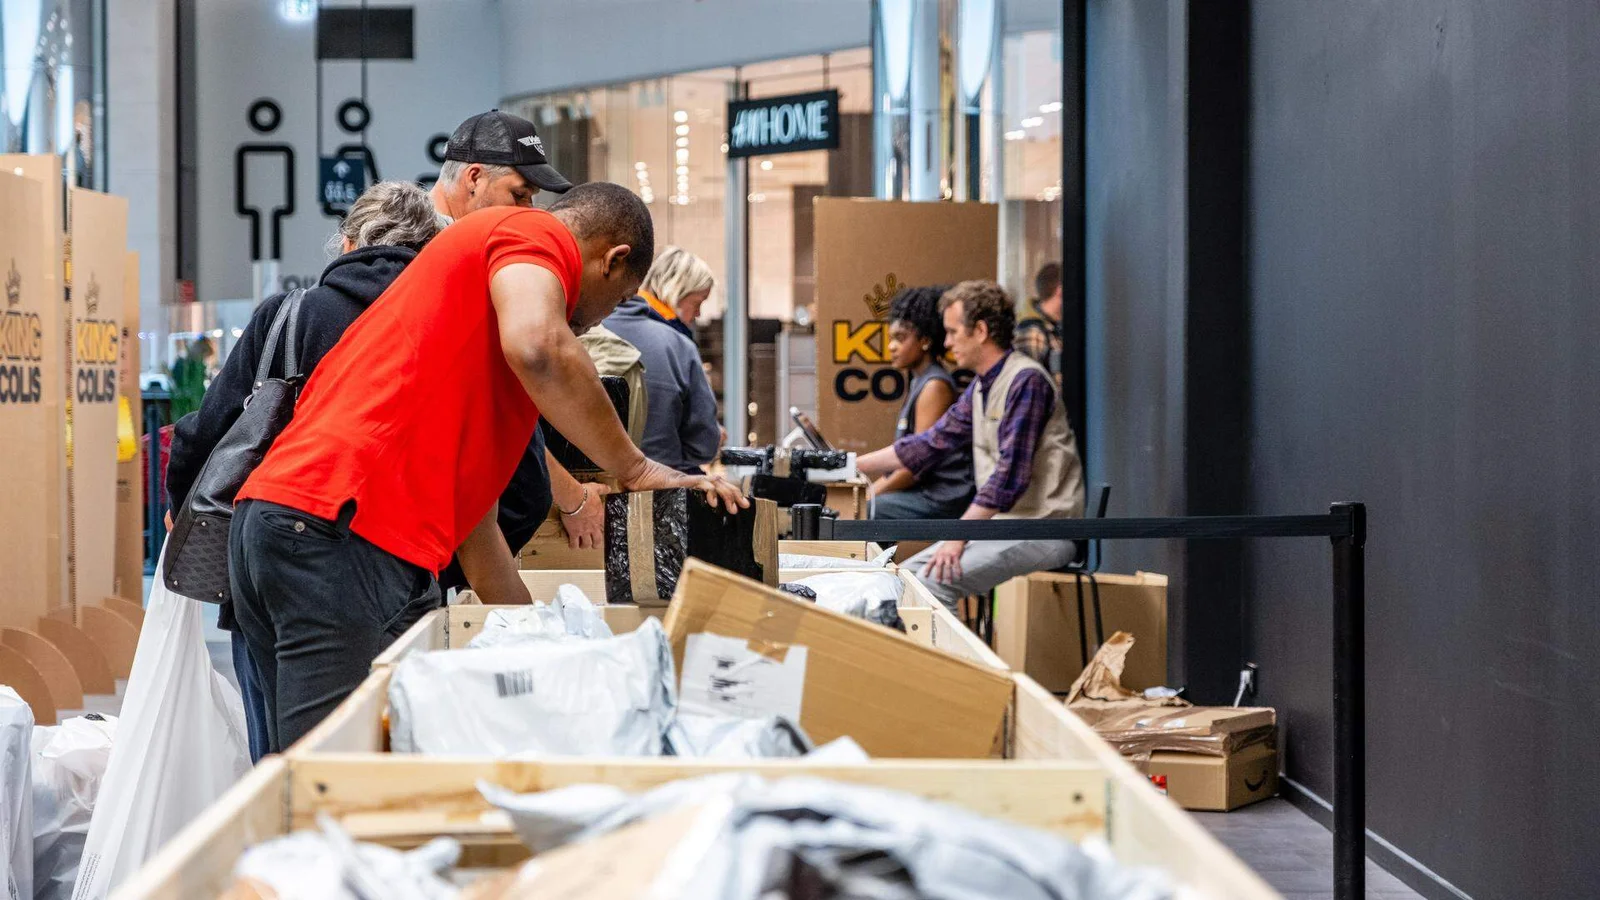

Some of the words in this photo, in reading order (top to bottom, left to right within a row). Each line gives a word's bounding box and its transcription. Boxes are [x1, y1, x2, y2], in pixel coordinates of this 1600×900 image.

[760, 99, 829, 145] HOME
[0, 310, 42, 361] KING
[76, 319, 118, 365] KING
[0, 365, 41, 403] COLIS
[77, 368, 116, 403] COLIS
